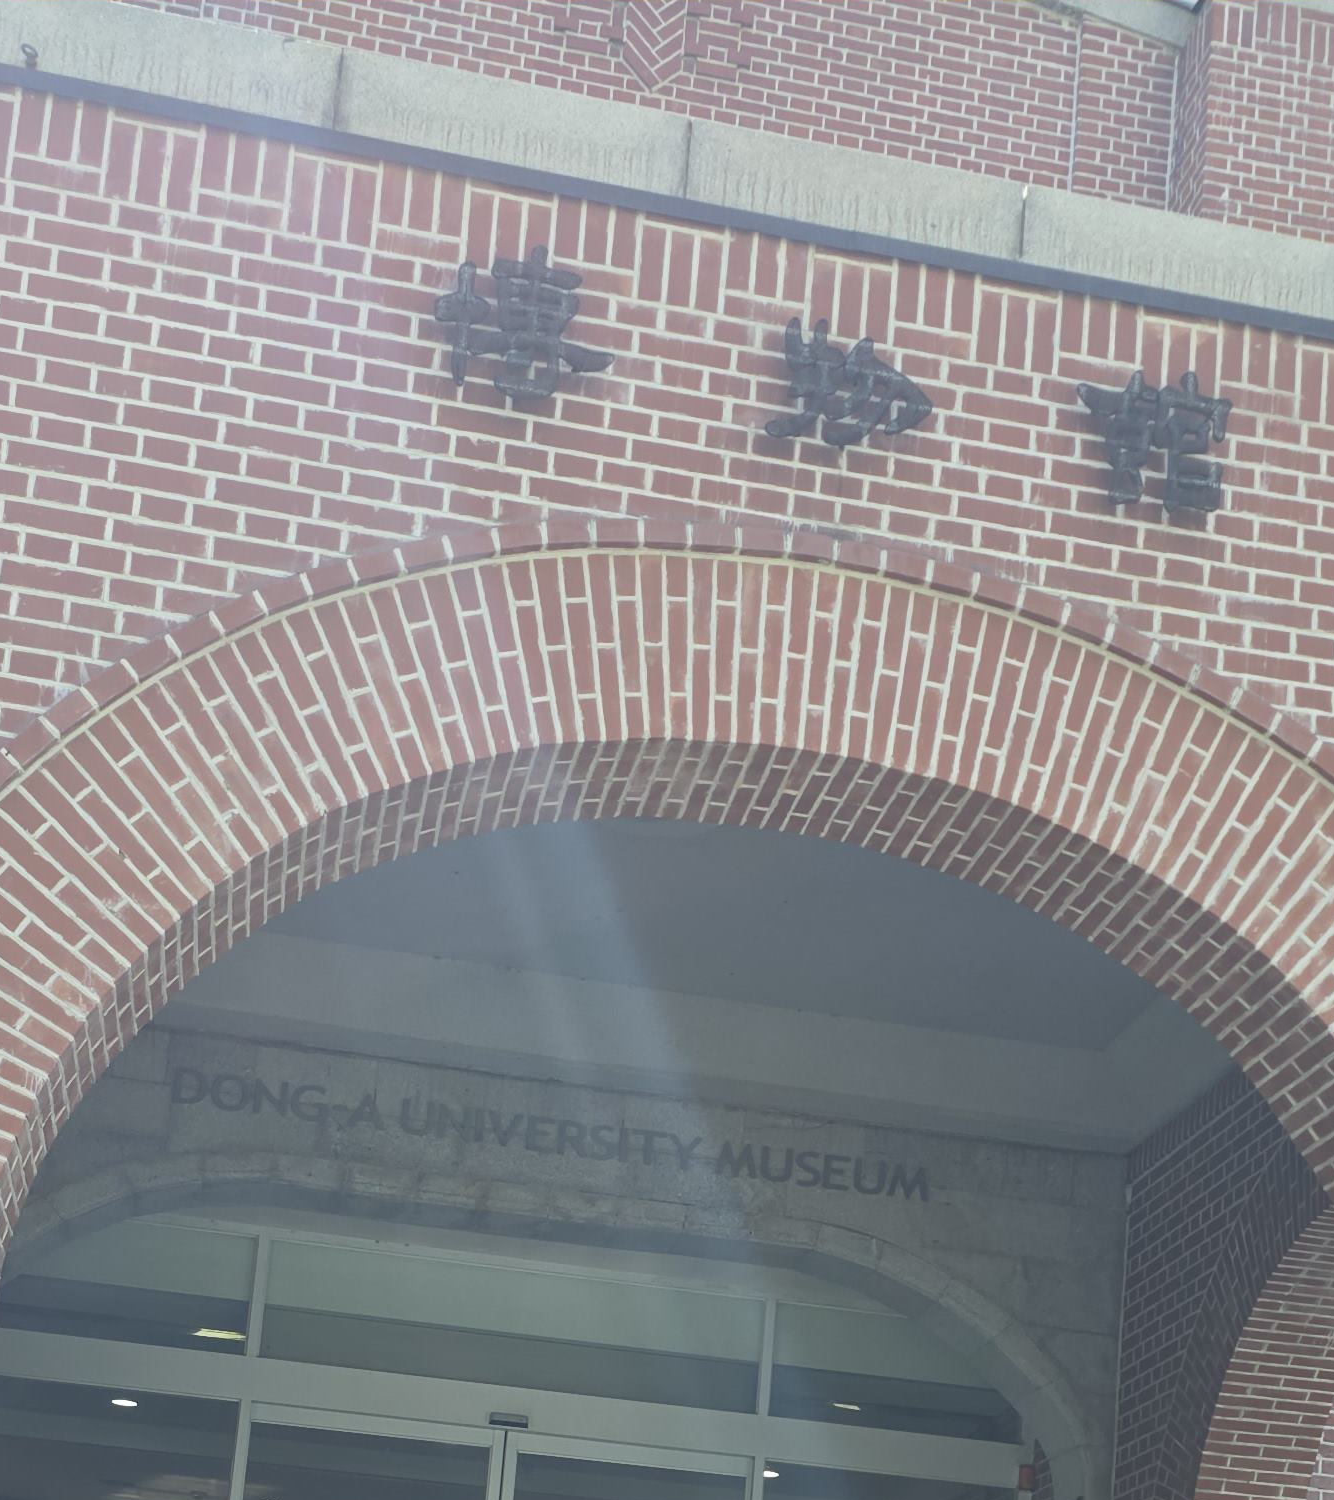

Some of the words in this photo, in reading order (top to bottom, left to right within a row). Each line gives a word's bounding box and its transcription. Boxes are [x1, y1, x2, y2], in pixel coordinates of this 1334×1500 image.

[170, 1065, 386, 1131] DONG-A
[399, 1095, 702, 1170] UNIVERSITY
[715, 1139, 931, 1202] MUSEUM
